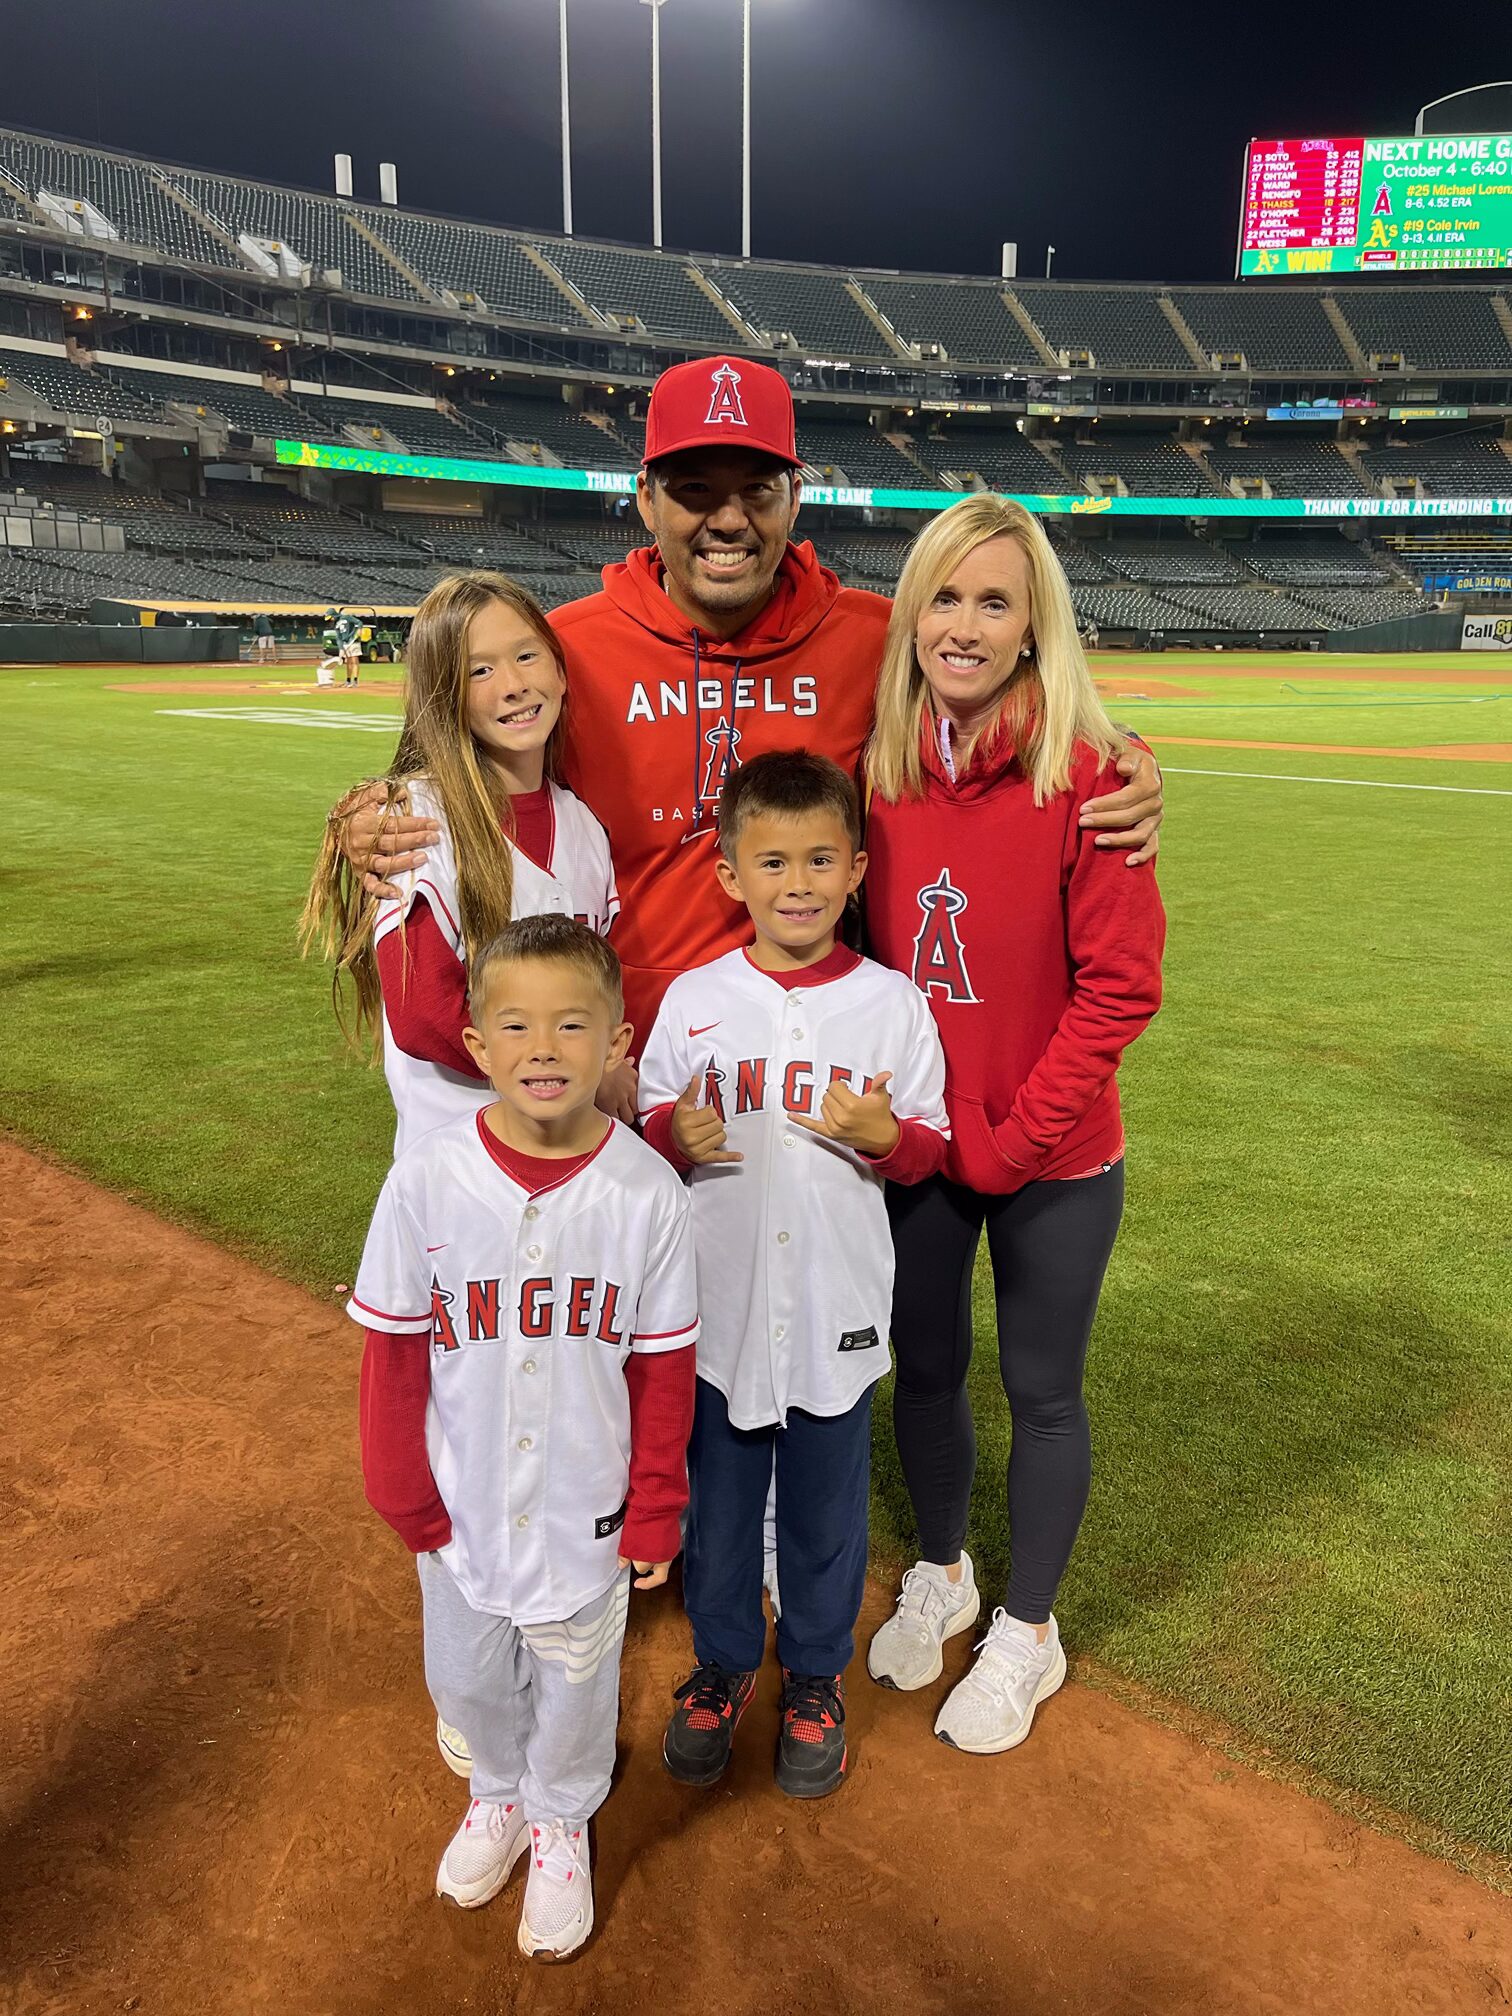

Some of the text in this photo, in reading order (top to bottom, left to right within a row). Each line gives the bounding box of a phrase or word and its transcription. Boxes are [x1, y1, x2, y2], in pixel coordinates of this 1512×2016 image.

[1265, 153, 1290, 161] SOTO
[1327, 151, 1339, 159] SS
[1366, 139, 1512, 161] NEXT HOME G
[1252, 163, 1263, 172] 27
[1264, 162, 1295, 171] TROUT
[1325, 161, 1338, 169] CF
[1383, 163, 1443, 178] October
[1445, 162, 1456, 176] 4
[1470, 161, 1507, 176] 6:40
[1251, 173, 1260, 181] 17
[1263, 171, 1298, 180] OHTANI
[1324, 170, 1338, 178] DH
[1262, 181, 1290, 190] WARD
[1324, 179, 1337, 188] RF
[1406, 185, 1430, 196] #25
[1432, 183, 1476, 196] Michael
[1262, 190, 1301, 199] RENGIFO
[1249, 201, 1258, 209] 12
[1262, 200, 1294, 209] THAISS
[1428, 197, 1450, 208] 4.52
[1451, 197, 1472, 207] ERA
[1248, 210, 1257, 218] 14
[1324, 207, 1332, 216] C
[1248, 220, 1254, 228] 7
[1259, 219, 1289, 228] ADELL
[1321, 217, 1334, 226] LF
[1403, 219, 1480, 231] #19 Cole Irvin
[1247, 231, 1258, 239] 22
[1259, 228, 1306, 239] FLETCHER
[1444, 232, 1465, 242] ERA
[1287, 250, 1333, 272] WIN!
[704, 363, 748, 426] A
[1289, 408, 1321, 419] Corona
[98, 420, 110, 432] 24
[585, 470, 632, 491] THANK
[837, 487, 874, 505] GAME
[1303, 499, 1350, 515] THANK
[1353, 499, 1381, 515] YOU
[1383, 499, 1410, 515] FOR
[1413, 499, 1493, 515] ATTENDING
[1457, 576, 1492, 589] GOLDEN
[1464, 624, 1493, 638] Call
[625, 676, 818, 723] ANGELS
[911, 867, 984, 1004] A
[430, 1271, 634, 1352] ANGEL
